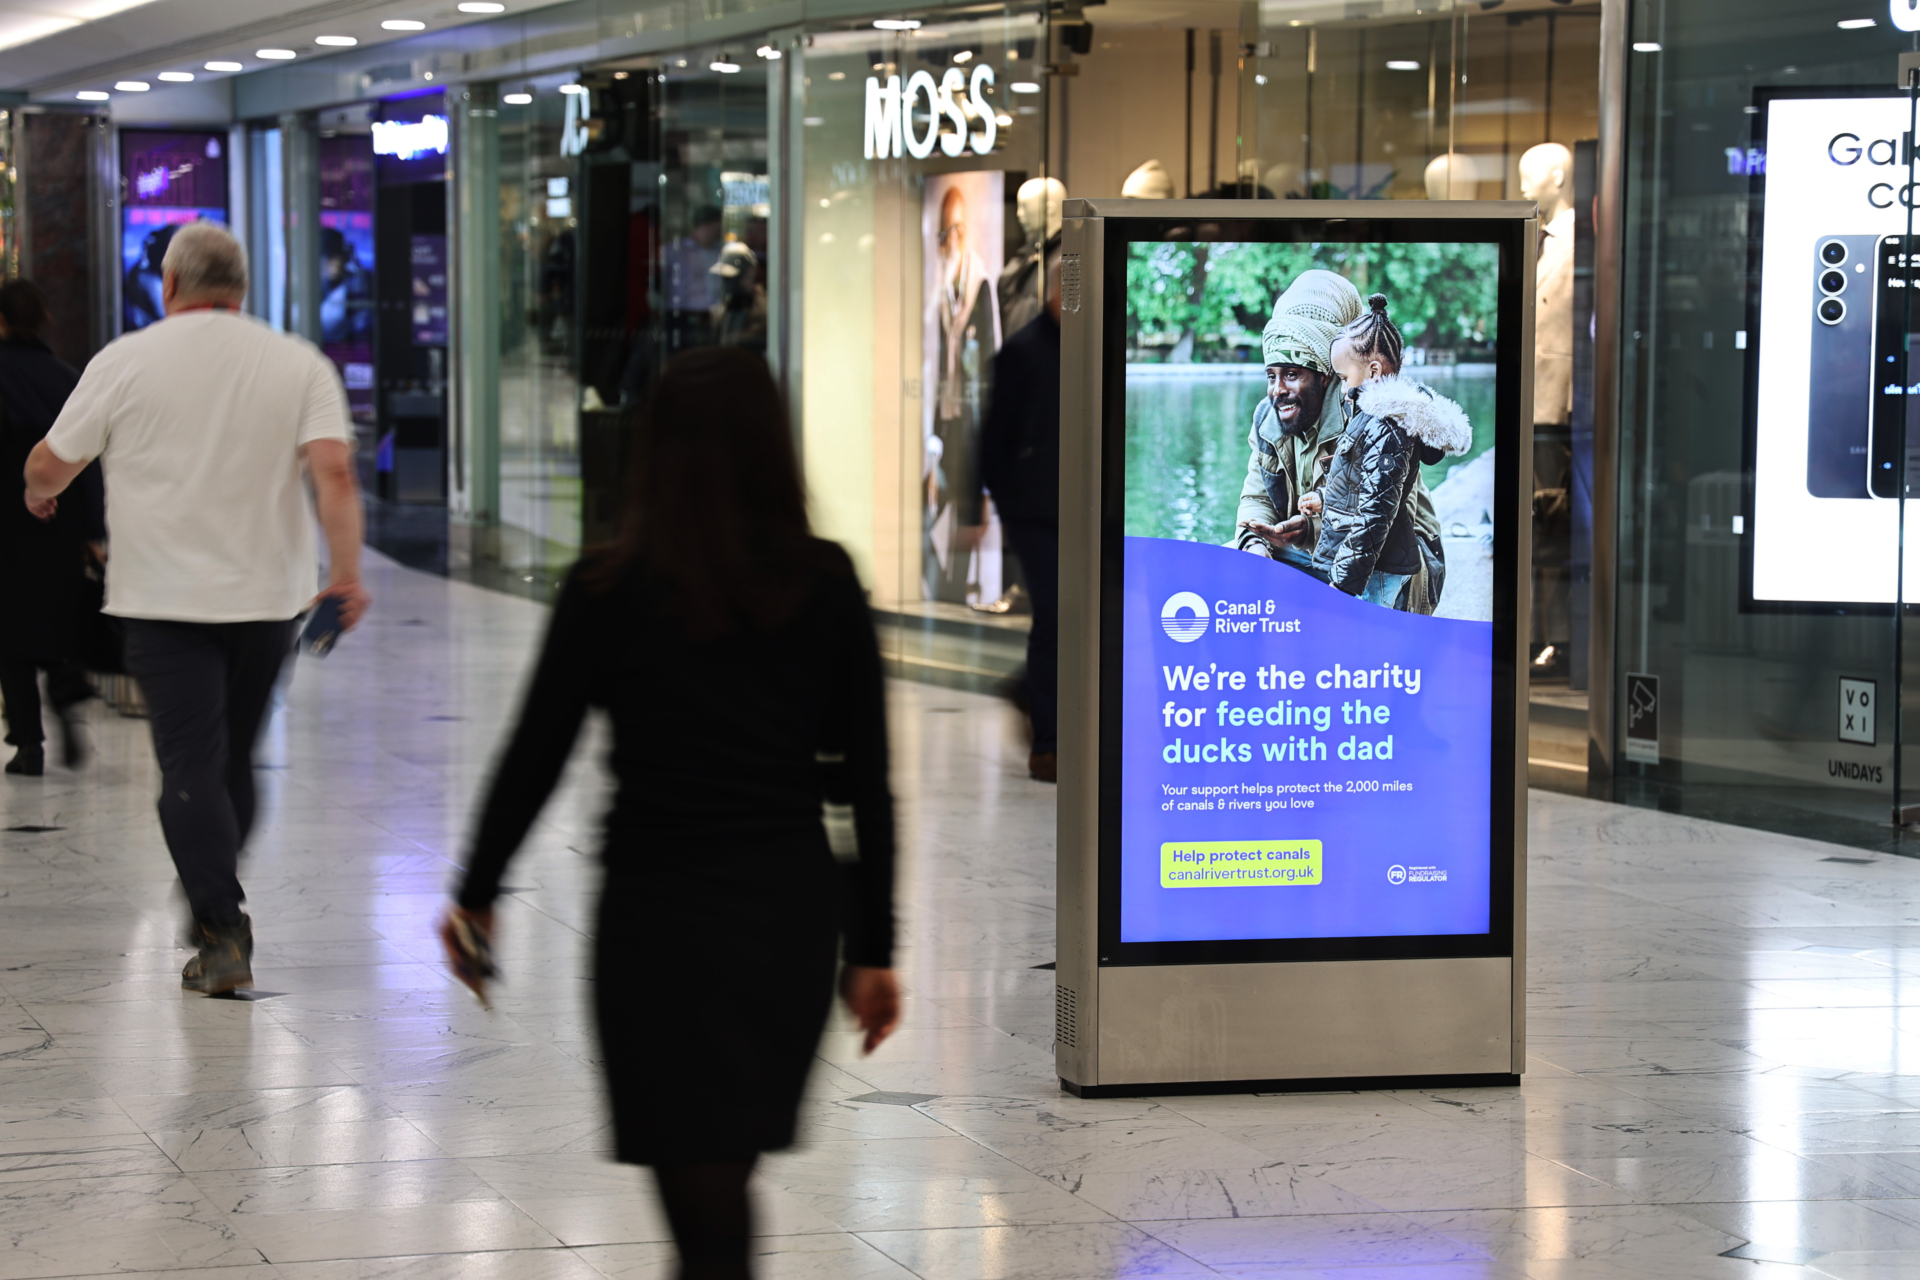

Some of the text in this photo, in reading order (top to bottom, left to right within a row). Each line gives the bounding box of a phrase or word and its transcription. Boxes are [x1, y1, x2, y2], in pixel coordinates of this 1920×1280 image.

[864, 63, 996, 159] MOSS
[1828, 132, 1920, 166] Gal
[1215, 600, 1276, 615] Canal &
[1215, 618, 1301, 634] River Trust
[1162, 662, 1421, 695] We're the charity
[1162, 699, 1391, 732] for feeding the
[1162, 735, 1394, 764] ducks with dad
[1161, 779, 1413, 799] Your support helps protect the 2,000 miles
[1161, 798, 1315, 812] of canals & rivers you love
[1173, 847, 1311, 865] Help protect canals
[1168, 865, 1314, 882] canalrivertrust.org.uk
[1391, 871, 1404, 879] FR
